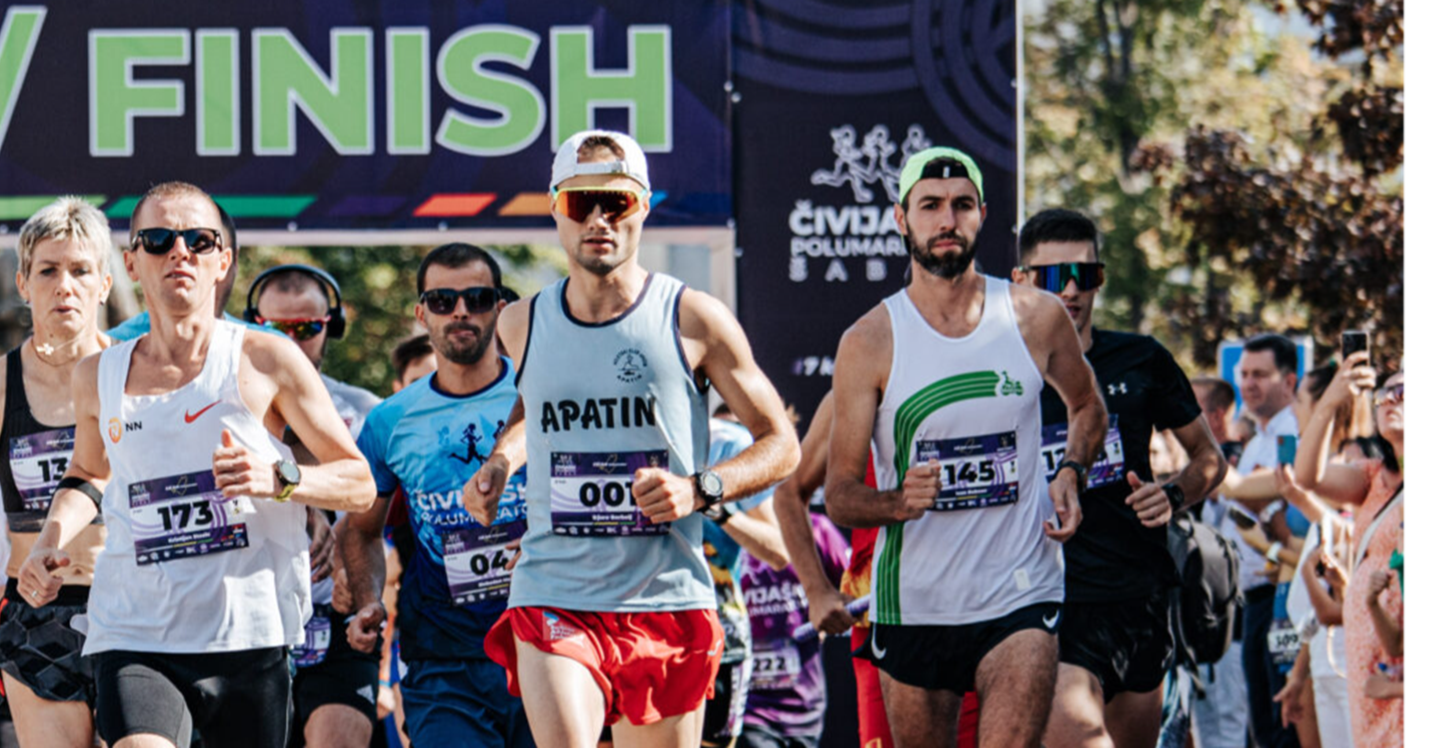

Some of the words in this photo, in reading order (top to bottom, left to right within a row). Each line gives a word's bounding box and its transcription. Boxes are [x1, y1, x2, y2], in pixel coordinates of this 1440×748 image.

[88, 25, 672, 157] FINISH
[789, 199, 898, 236] ČIVIJA
[790, 236, 906, 258] POLUMAR
[125, 421, 142, 432] NN
[541, 396, 656, 433] APATIN
[38, 457, 69, 483] 13
[944, 460, 995, 486] 145
[580, 482, 637, 507] 001
[157, 500, 213, 531] 173
[470, 550, 510, 576] 04
